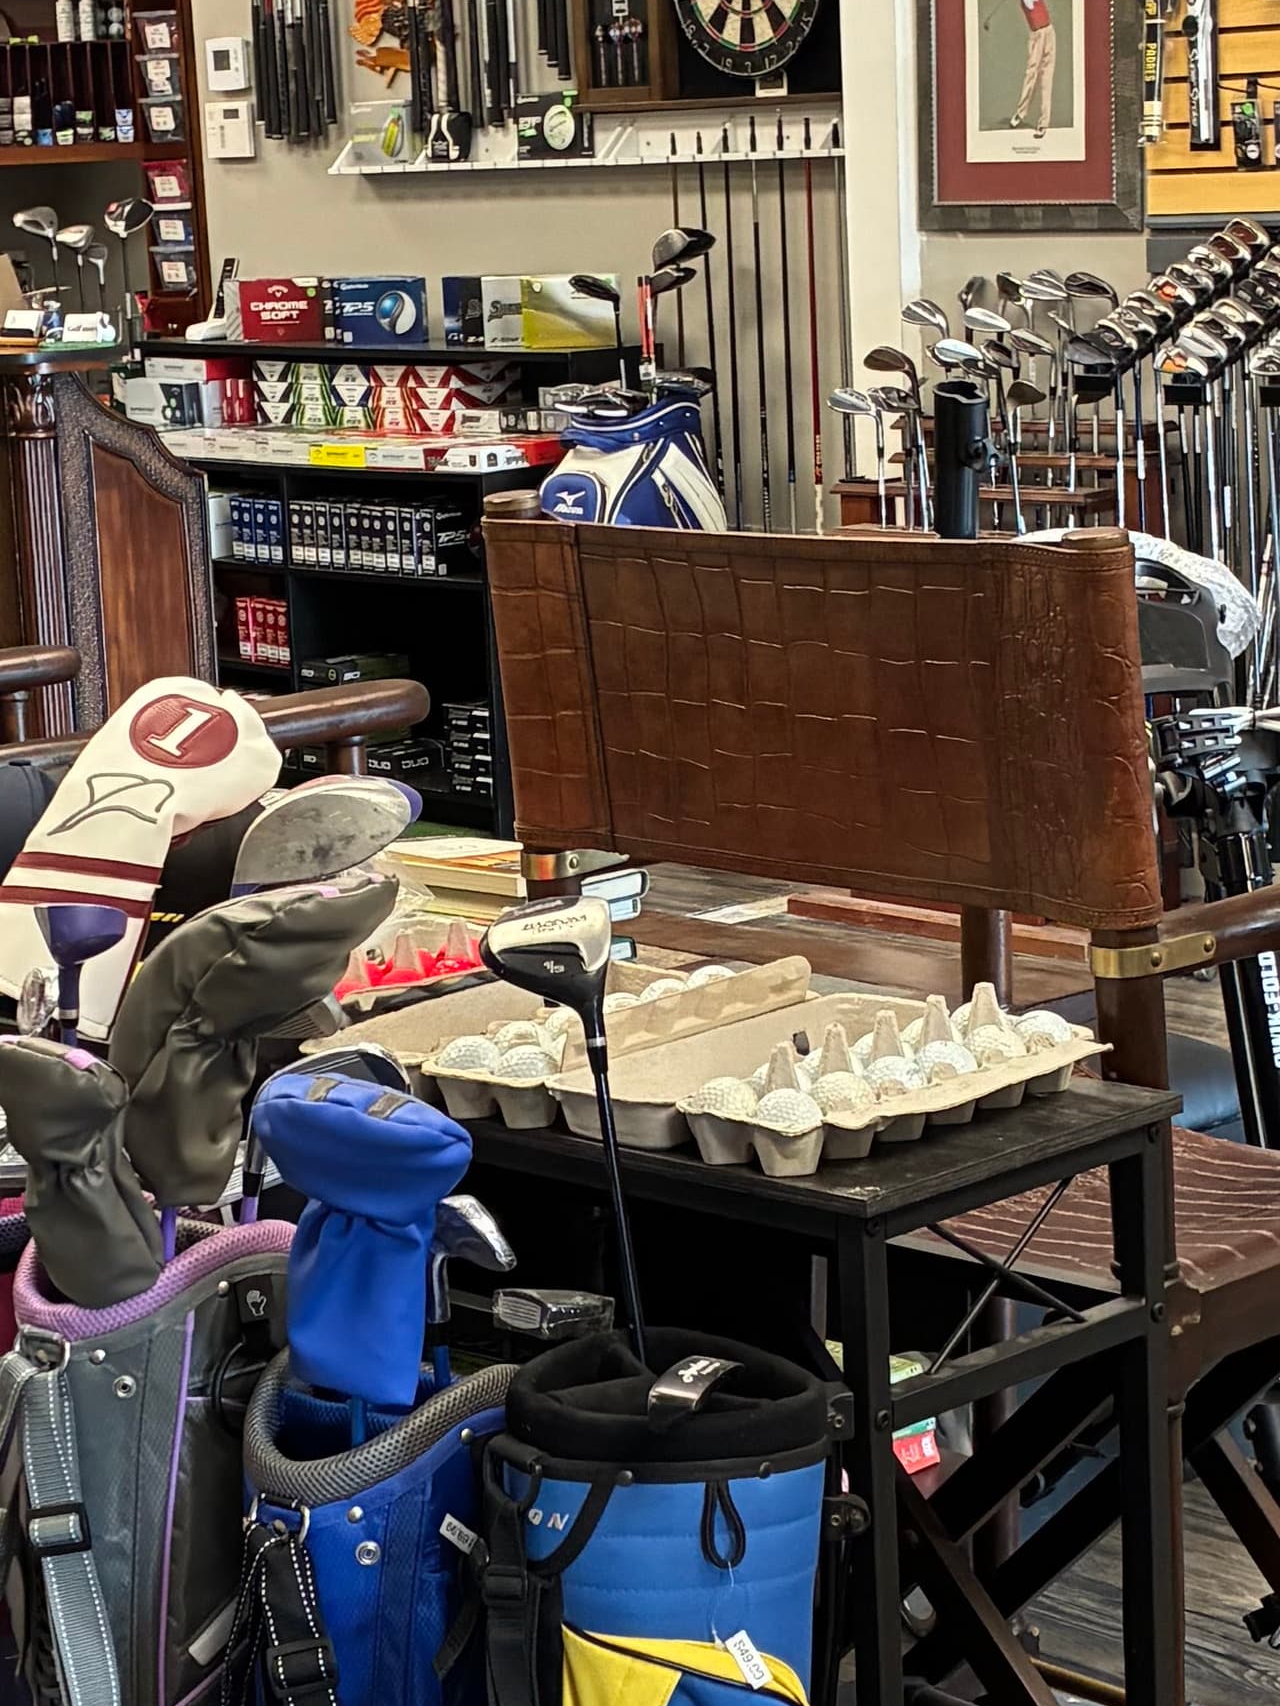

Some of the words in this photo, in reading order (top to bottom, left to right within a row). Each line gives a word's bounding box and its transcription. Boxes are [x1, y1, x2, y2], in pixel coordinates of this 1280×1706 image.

[1144, 42, 1158, 83] PADRES
[250, 298, 308, 313] CHROME
[341, 299, 376, 318] TP5
[261, 307, 299, 322] SOFT
[146, 707, 213, 759] 1
[401, 756, 429, 769] DUO
